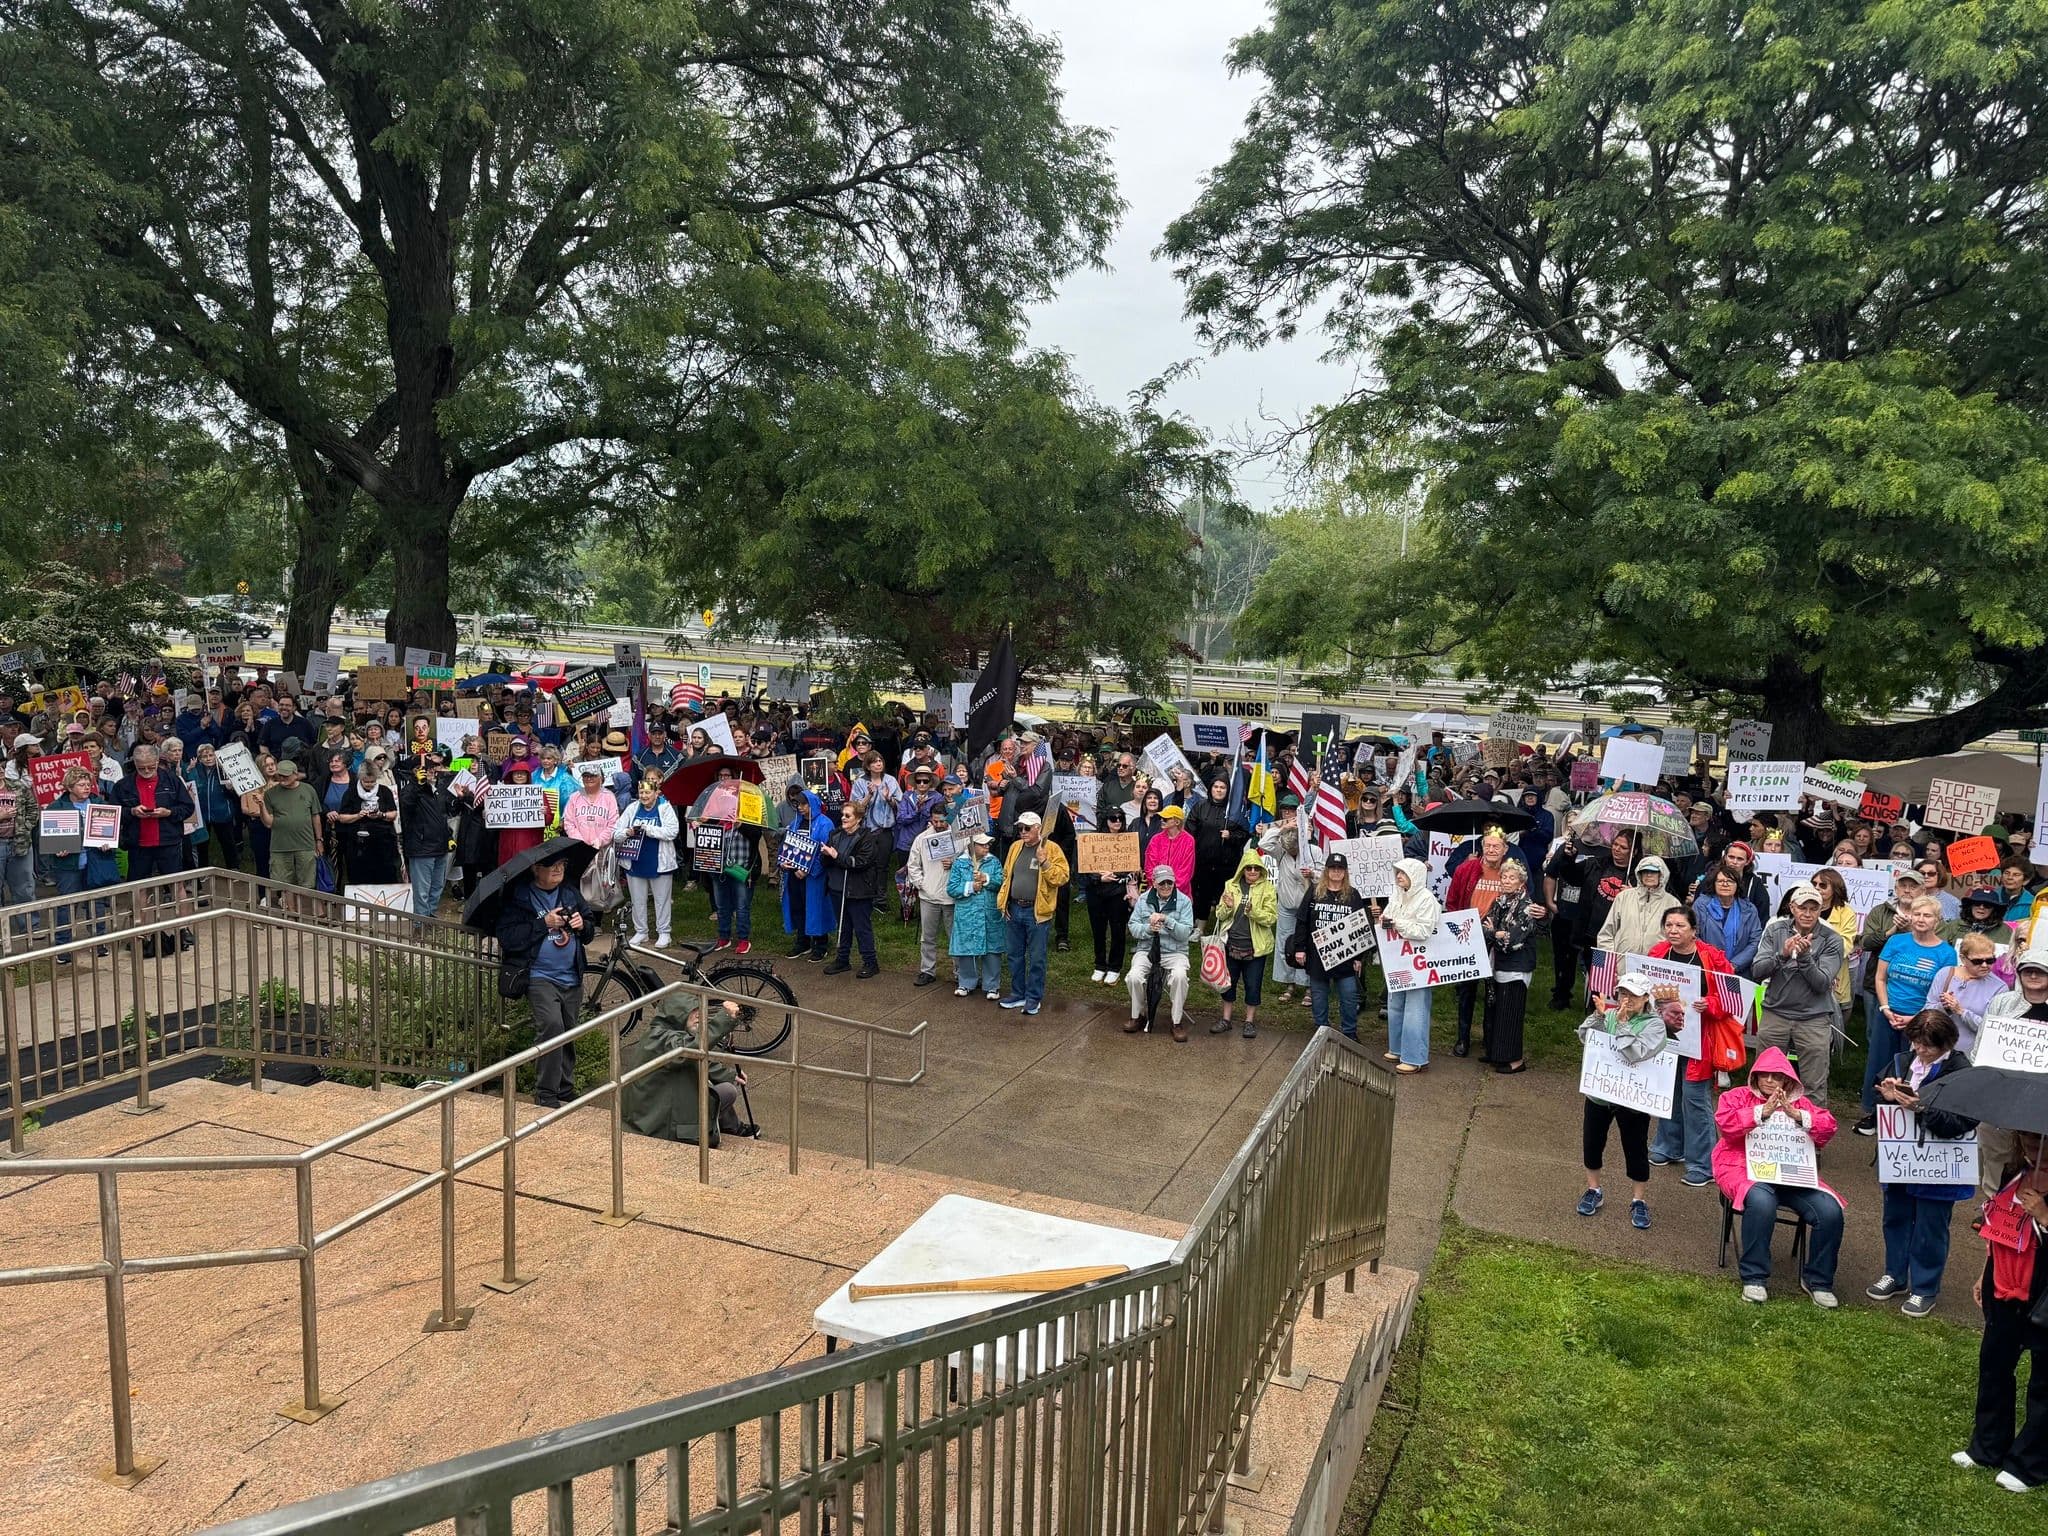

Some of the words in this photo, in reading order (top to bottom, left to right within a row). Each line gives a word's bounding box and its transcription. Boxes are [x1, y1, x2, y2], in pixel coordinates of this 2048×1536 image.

[198, 636, 240, 644] LIBERTY
[414, 667, 454, 677] HANDS
[571, 672, 598, 688] BELIEVE
[1202, 702, 1219, 715] NO
[1223, 702, 1268, 717] KINGS!
[1134, 716, 1168, 726] KINGS
[1730, 721, 1770, 736] DEMOCRACY
[1509, 732, 1528, 740] LIES
[1740, 739, 1756, 747] NO
[1728, 750, 1764, 762] KINGS
[35, 759, 60, 772] FIRST
[60, 756, 82, 767] THEY
[1751, 764, 1800, 774] FELONIES
[36, 770, 60, 782] TOOK
[1827, 764, 1858, 781] SAVE
[1739, 776, 1790, 786] PRISON
[1803, 776, 1862, 799] DEMOCRACY!
[487, 788, 524, 797] CORRUPT
[525, 787, 542, 796] RICH
[1931, 780, 1976, 797] STOP
[1977, 790, 1994, 800] THE
[489, 800, 508, 809] ARE
[1735, 794, 1790, 803] PRESIDENT
[1871, 793, 1890, 805] NO
[1927, 794, 1995, 817] FASCIST
[486, 813, 510, 823] GOOD
[575, 805, 610, 820] LONDON
[1858, 805, 1899, 820] KINGS
[1925, 808, 1984, 832] CREEP
[698, 826, 722, 837] HANDS
[697, 837, 721, 849] OFF!
[784, 834, 815, 853] RESIST!
[1352, 840, 1382, 850] DUE
[1354, 874, 1369, 886] OF
[1314, 903, 1352, 912] IMMIGRANTS
[1319, 911, 1331, 920] ARE
[1330, 922, 1345, 935] NO
[1319, 938, 1345, 956] FAUX
[1348, 924, 1370, 942] KING
[1337, 943, 1359, 961] WAY
[1401, 941, 1426, 956] Are
[1413, 954, 1476, 971] Governing
[1651, 965, 1671, 974] CROWN
[1427, 969, 1480, 984] America
[1648, 972, 1669, 980] CHEETO
[1671, 976, 1690, 984] CLOWN
[1986, 1020, 2048, 1040] IMMIGR
[1589, 1031, 1604, 1048] Are
[1998, 1035, 2031, 1049] MAKE
[1601, 1064, 1624, 1082] Just
[1629, 1073, 1648, 1090] Feel
[1584, 1072, 1671, 1112] EMBARRASSED
[1880, 1106, 1906, 1139] NO
[1761, 1132, 1806, 1143] DICTATORS
[1753, 1142, 1790, 1152] ALLOWED
[1884, 1144, 1909, 1160] We
[1912, 1145, 1948, 1162] Won't
[1953, 1147, 1969, 1163] Be
[1768, 1152, 1809, 1166] AMERICA!
[1893, 1162, 1948, 1178] Silenced
[1989, 1228, 2000, 1236] NO
